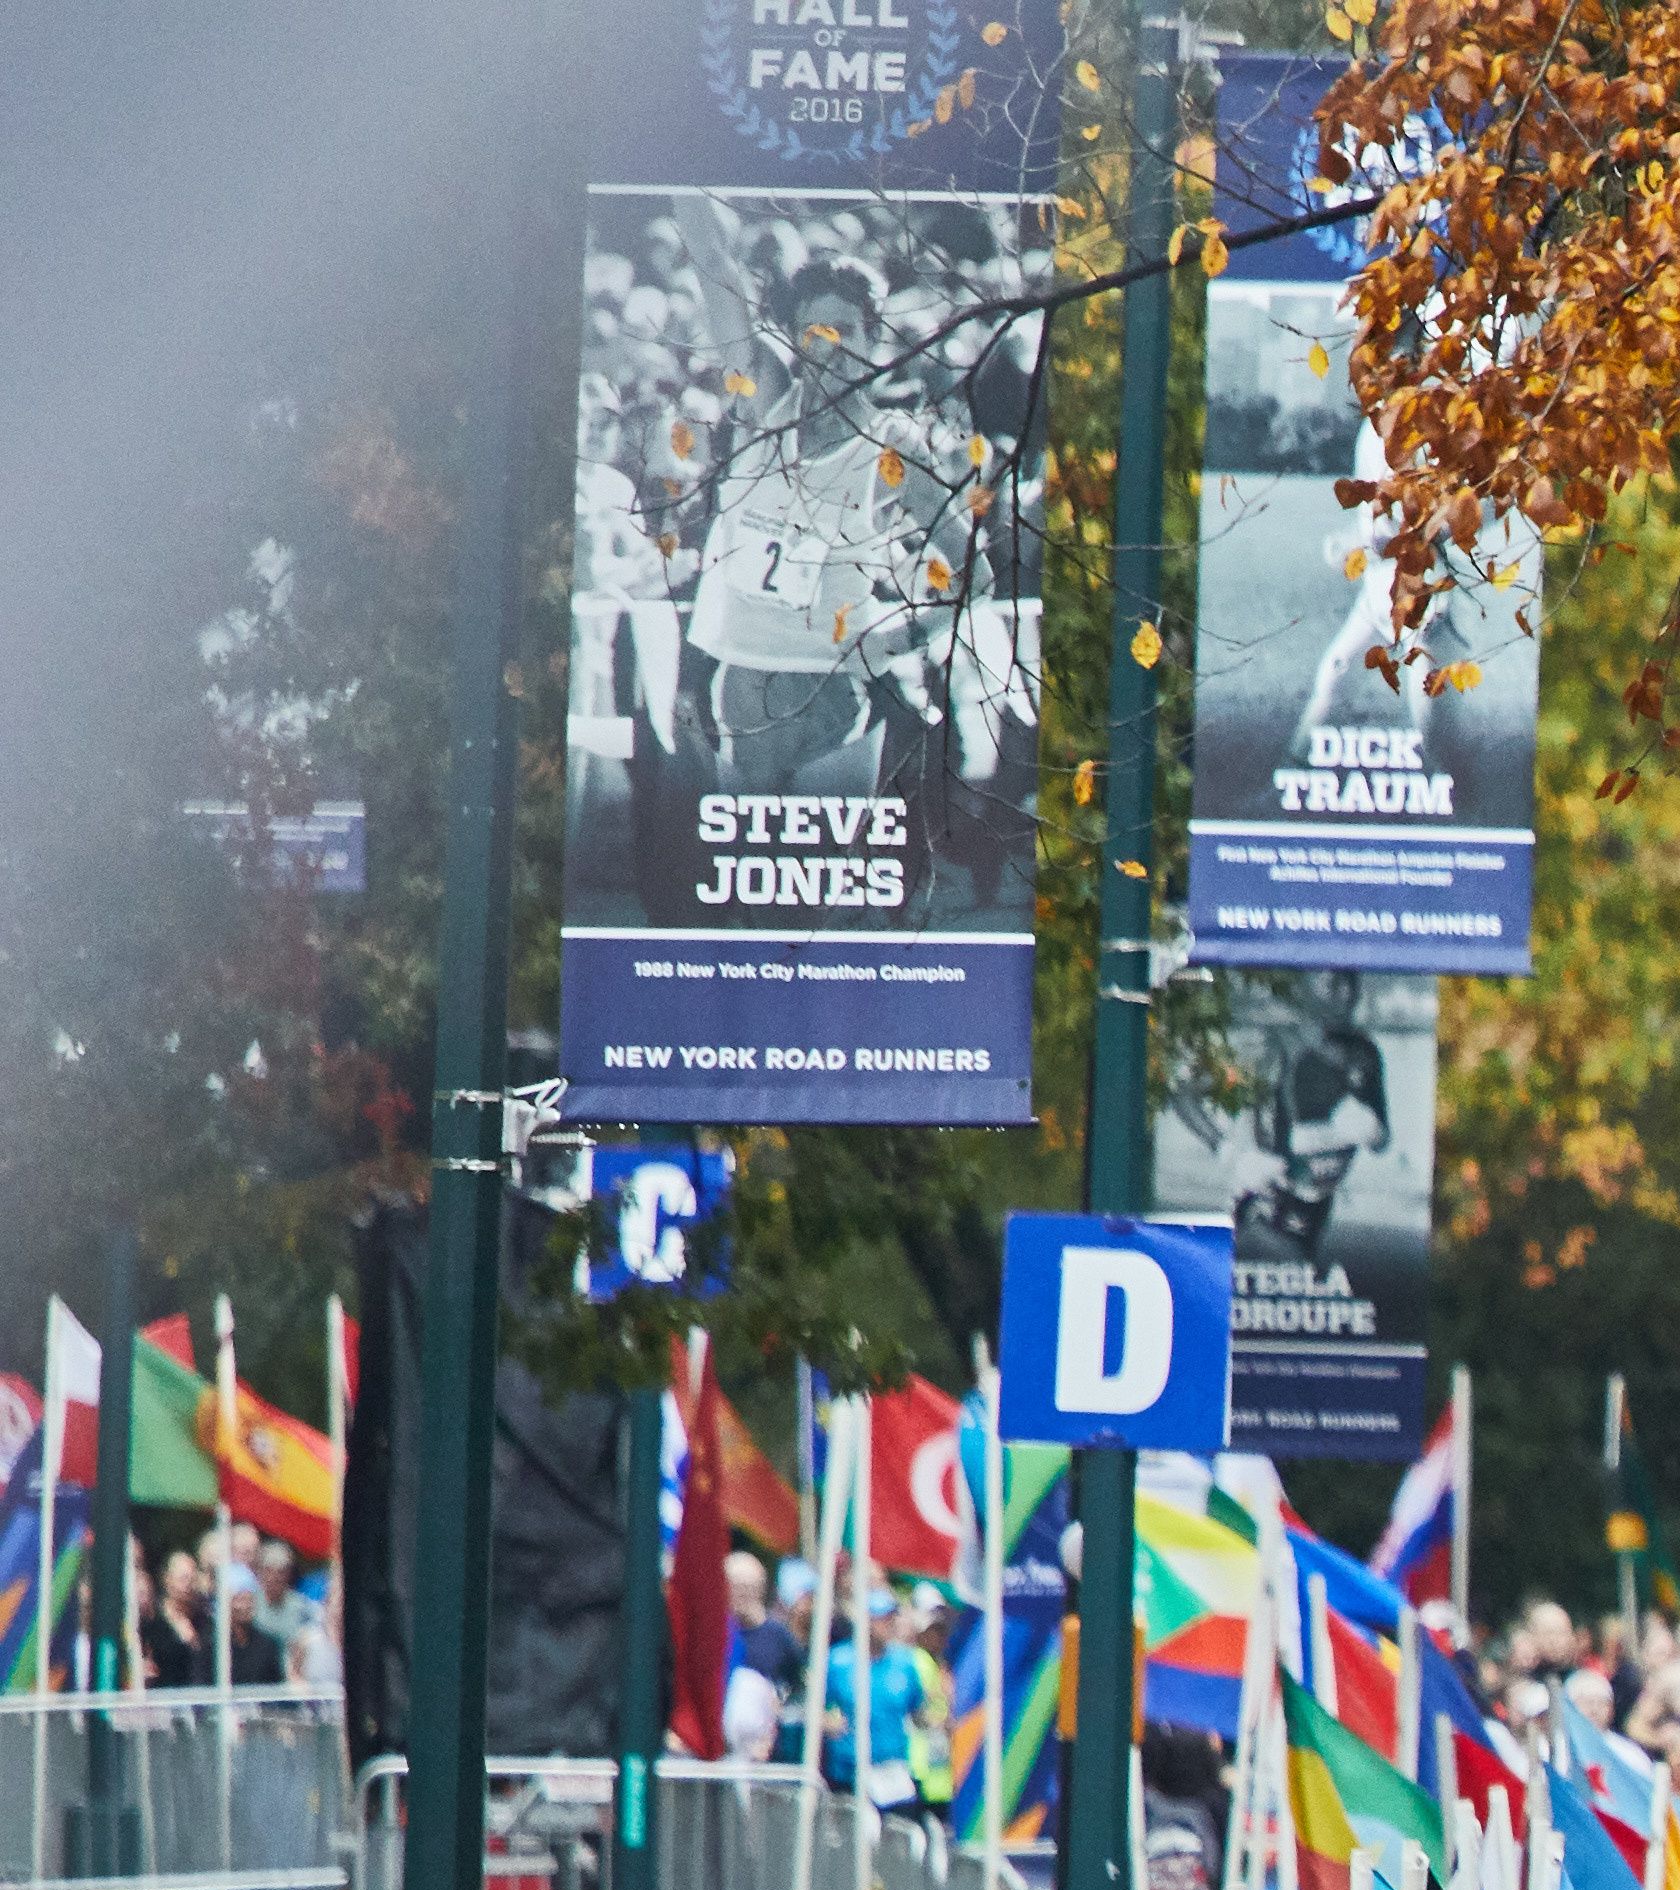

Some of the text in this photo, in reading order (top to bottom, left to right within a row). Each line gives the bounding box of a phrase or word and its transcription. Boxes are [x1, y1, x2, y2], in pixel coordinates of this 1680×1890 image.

[752, 0, 908, 27] HALL
[814, 29, 847, 47] OF
[750, 49, 907, 92] FAME
[790, 97, 863, 122] 2016
[1308, 725, 1424, 770] DICK
[1273, 769, 1454, 815] TRAUM
[699, 795, 907, 845] STEVE
[696, 856, 904, 907] JONES
[1217, 906, 1503, 937] NEW YORK ROAD RUNNERS
[676, 961, 715, 978] New
[718, 962, 757, 980] York
[797, 964, 878, 982] Marathon
[879, 965, 966, 984] Champion
[604, 1045, 992, 1073] NEW YORK ROAD RUNNERS
[620, 1162, 698, 1284] C
[1055, 1246, 1173, 1415] D
[1232, 1299, 1377, 1335] OROUPE
